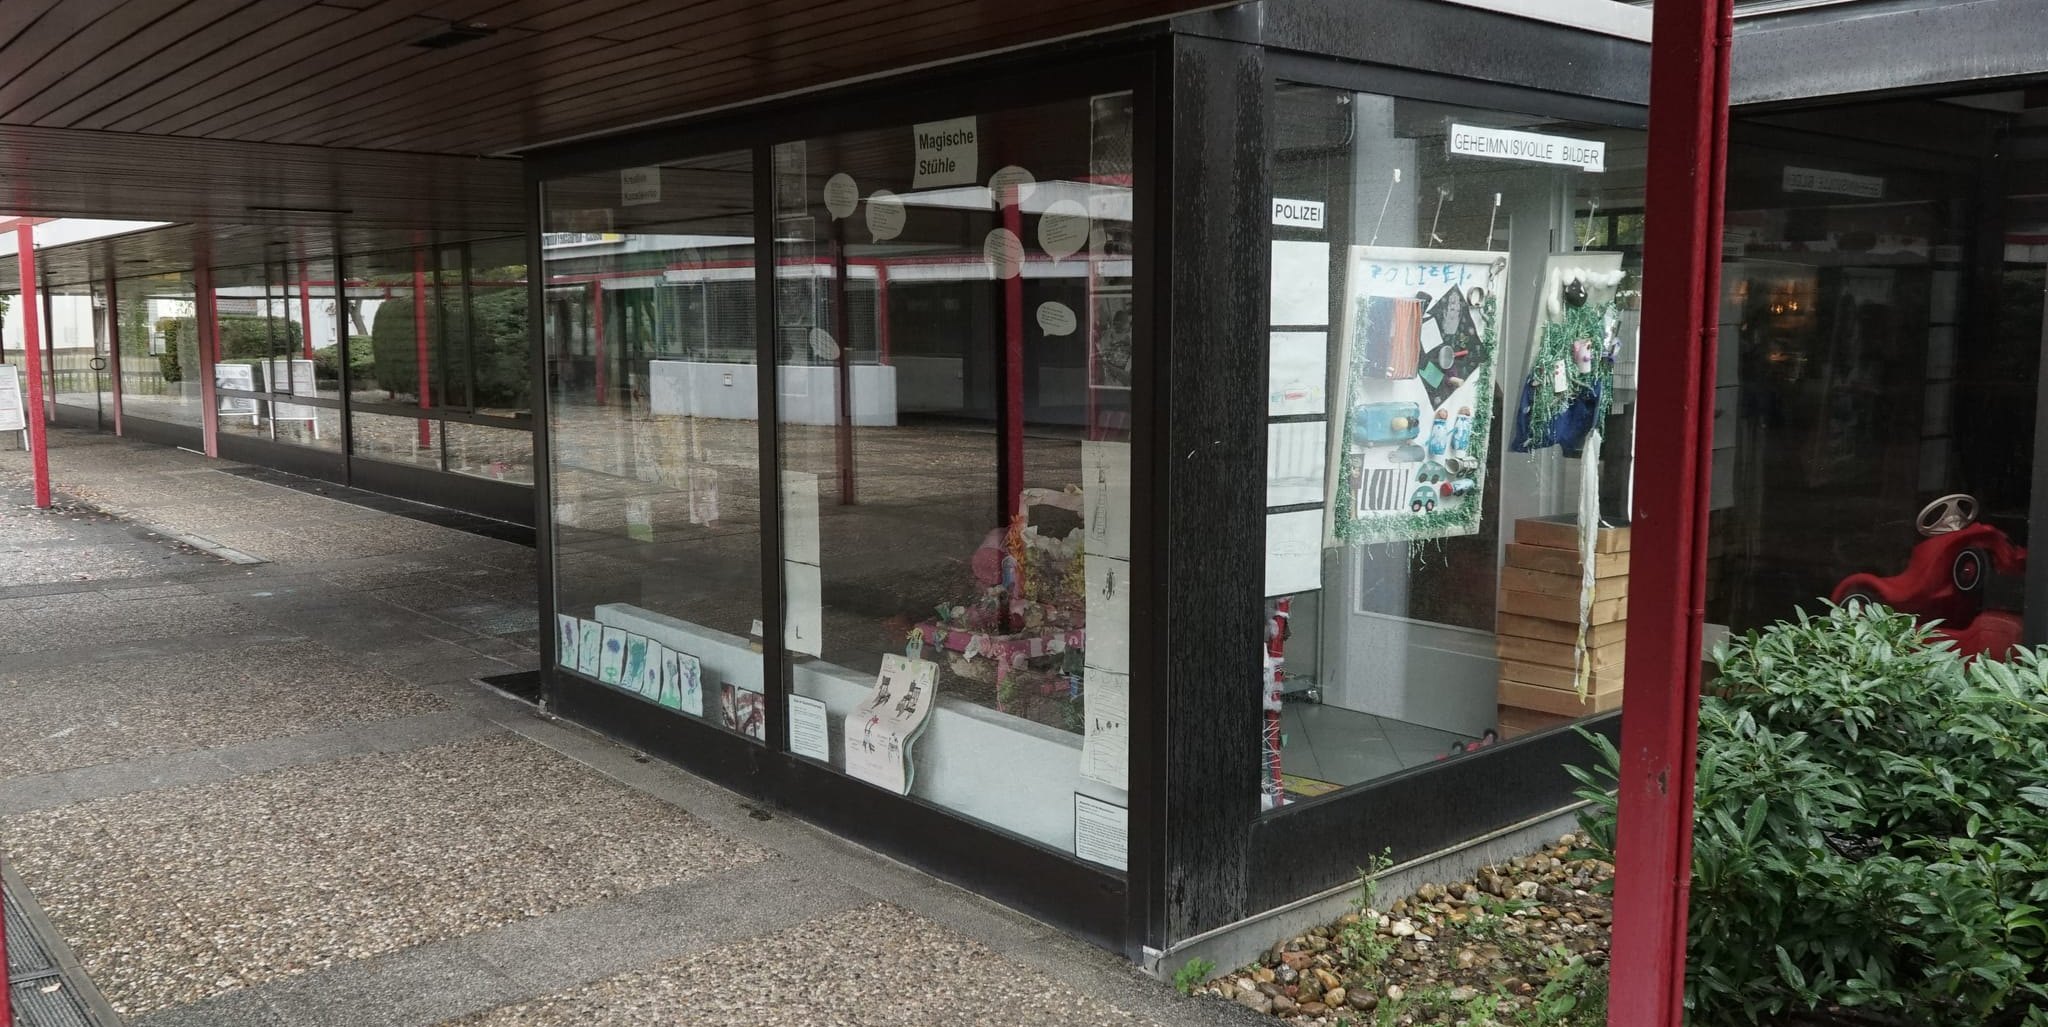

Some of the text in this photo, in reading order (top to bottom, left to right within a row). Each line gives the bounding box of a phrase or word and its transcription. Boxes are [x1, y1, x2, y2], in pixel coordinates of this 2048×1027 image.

[919, 129, 974, 152] Magische
[1454, 133, 1599, 165] GEHEIMNISVOLLE BILDER
[919, 157, 956, 176] Stühle
[1275, 203, 1321, 222] POLIZEI
